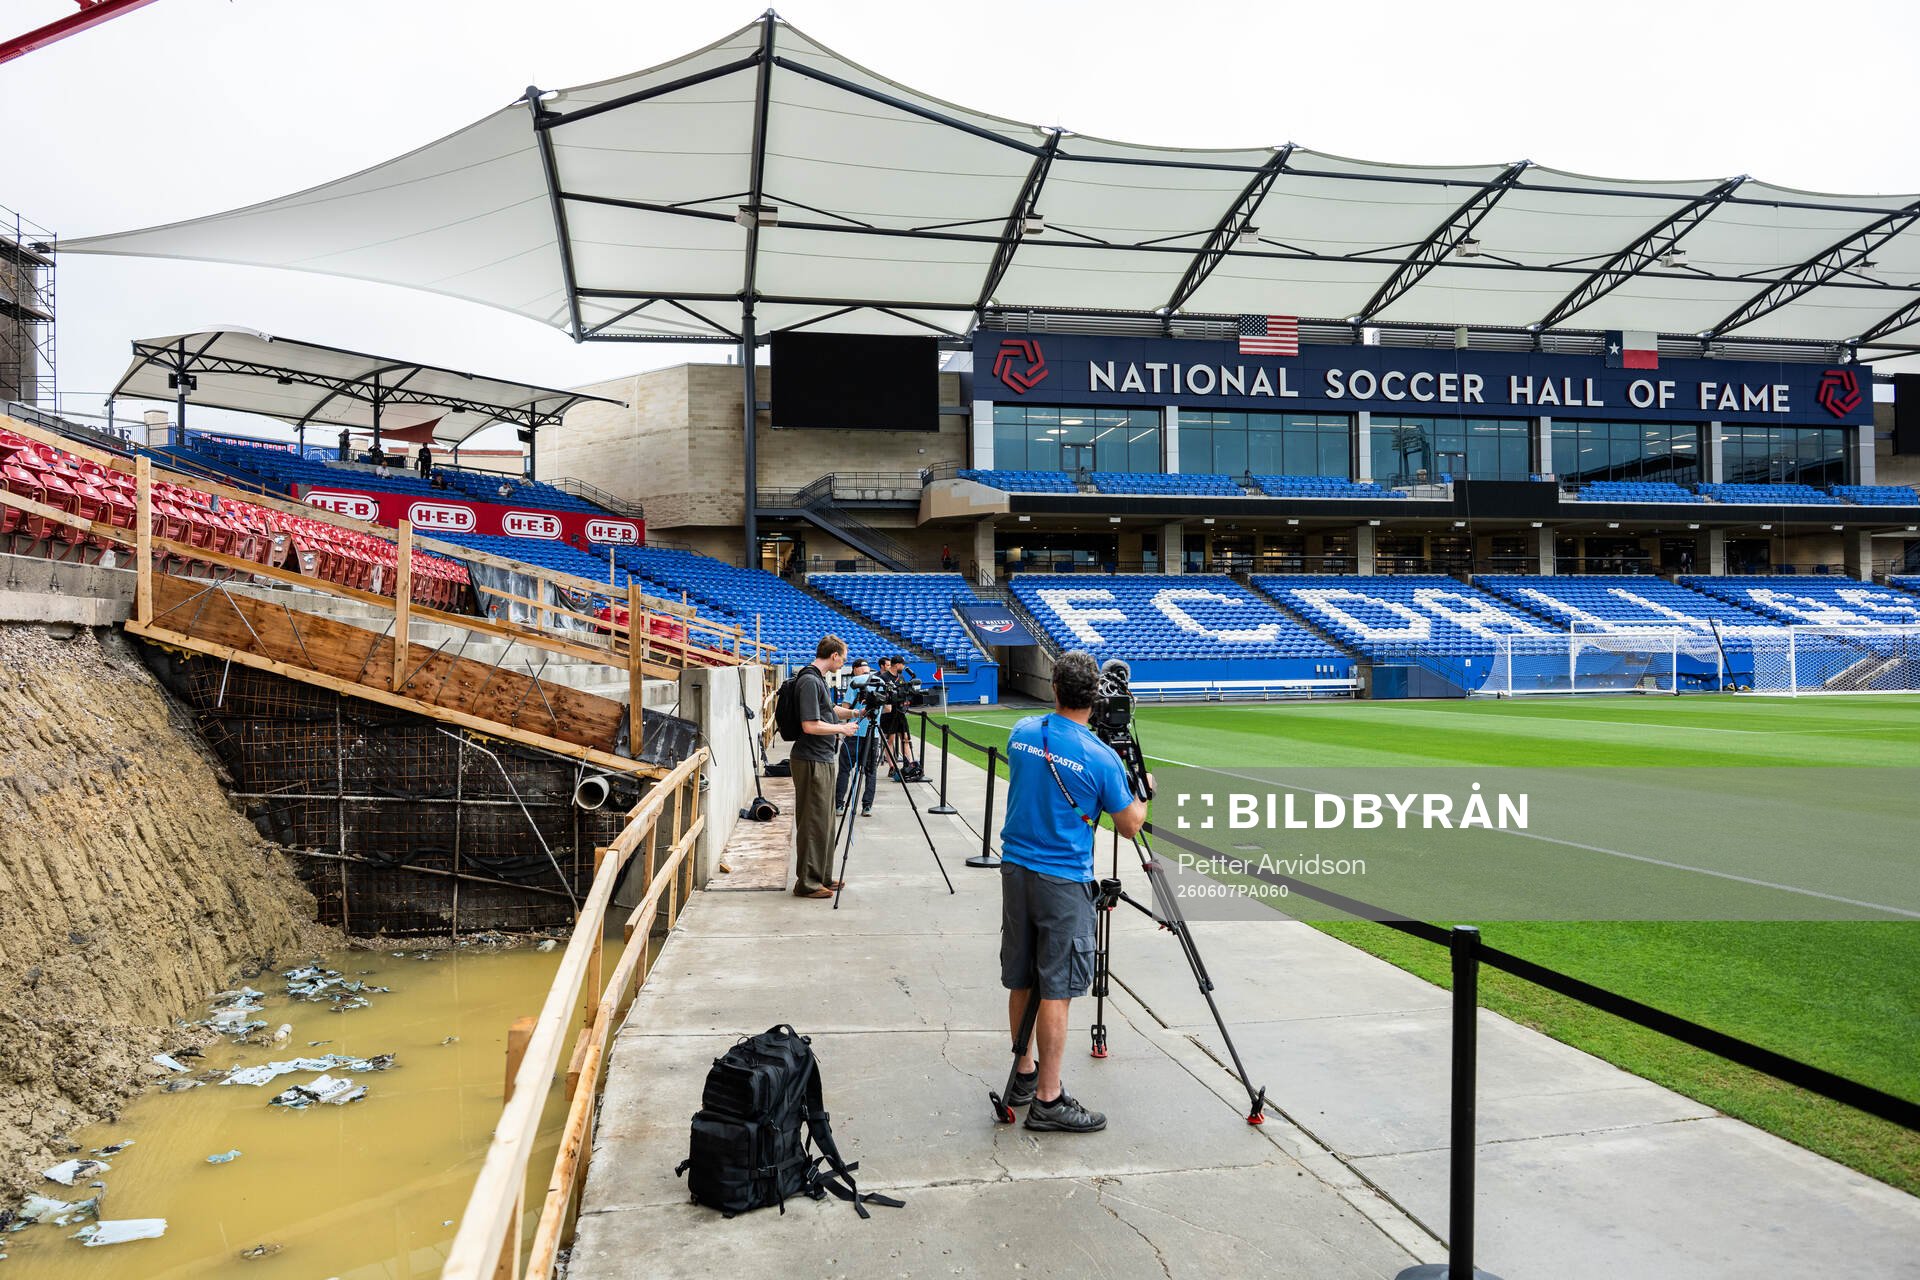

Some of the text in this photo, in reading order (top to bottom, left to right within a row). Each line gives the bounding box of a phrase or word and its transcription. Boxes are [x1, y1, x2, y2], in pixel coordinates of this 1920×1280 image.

[1089, 360, 1790, 412] NATIONAL SOCCER HALL OF FAME
[1036, 589, 1281, 643] FC
[1011, 741, 1028, 751] HOST
